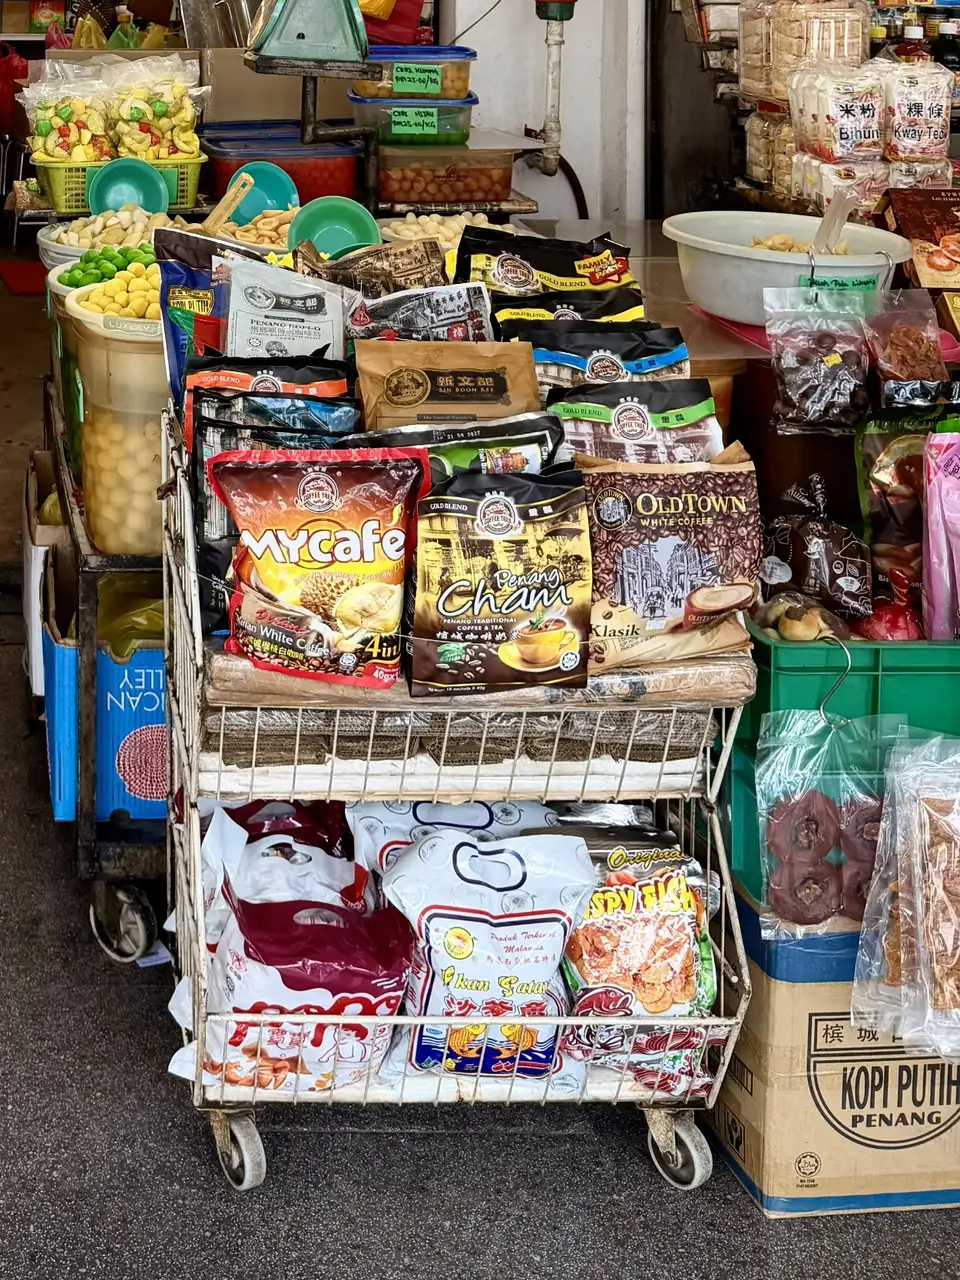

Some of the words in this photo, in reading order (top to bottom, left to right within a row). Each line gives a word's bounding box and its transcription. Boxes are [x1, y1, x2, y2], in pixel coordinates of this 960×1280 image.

[839, 102, 876, 119] 米粉
[839, 126, 879, 141] Bihun
[894, 125, 922, 142] Kway
[577, 254, 612, 271] FAMILY
[539, 273, 560, 286] GOLD
[250, 319, 285, 328] PENANG
[562, 407, 579, 415] GOLD
[580, 407, 603, 417] BLEND
[429, 502, 445, 511] GOLD
[445, 503, 468, 512] BLEND
[636, 492, 747, 515] OLDTOWN
[640, 517, 675, 527] WHITE
[677, 517, 714, 526] COFFEE
[494, 568, 560, 589] Penang
[437, 578, 574, 617] Cham
[590, 623, 640, 637] Klasik
[260, 621, 294, 646] White
[296, 637, 330, 657] Coffee
[641, 870, 697, 915] FISH
[841, 1064, 889, 1110] KOPI
[897, 1062, 960, 1108] PUTIH
[851, 1110, 942, 1129] PENANG
